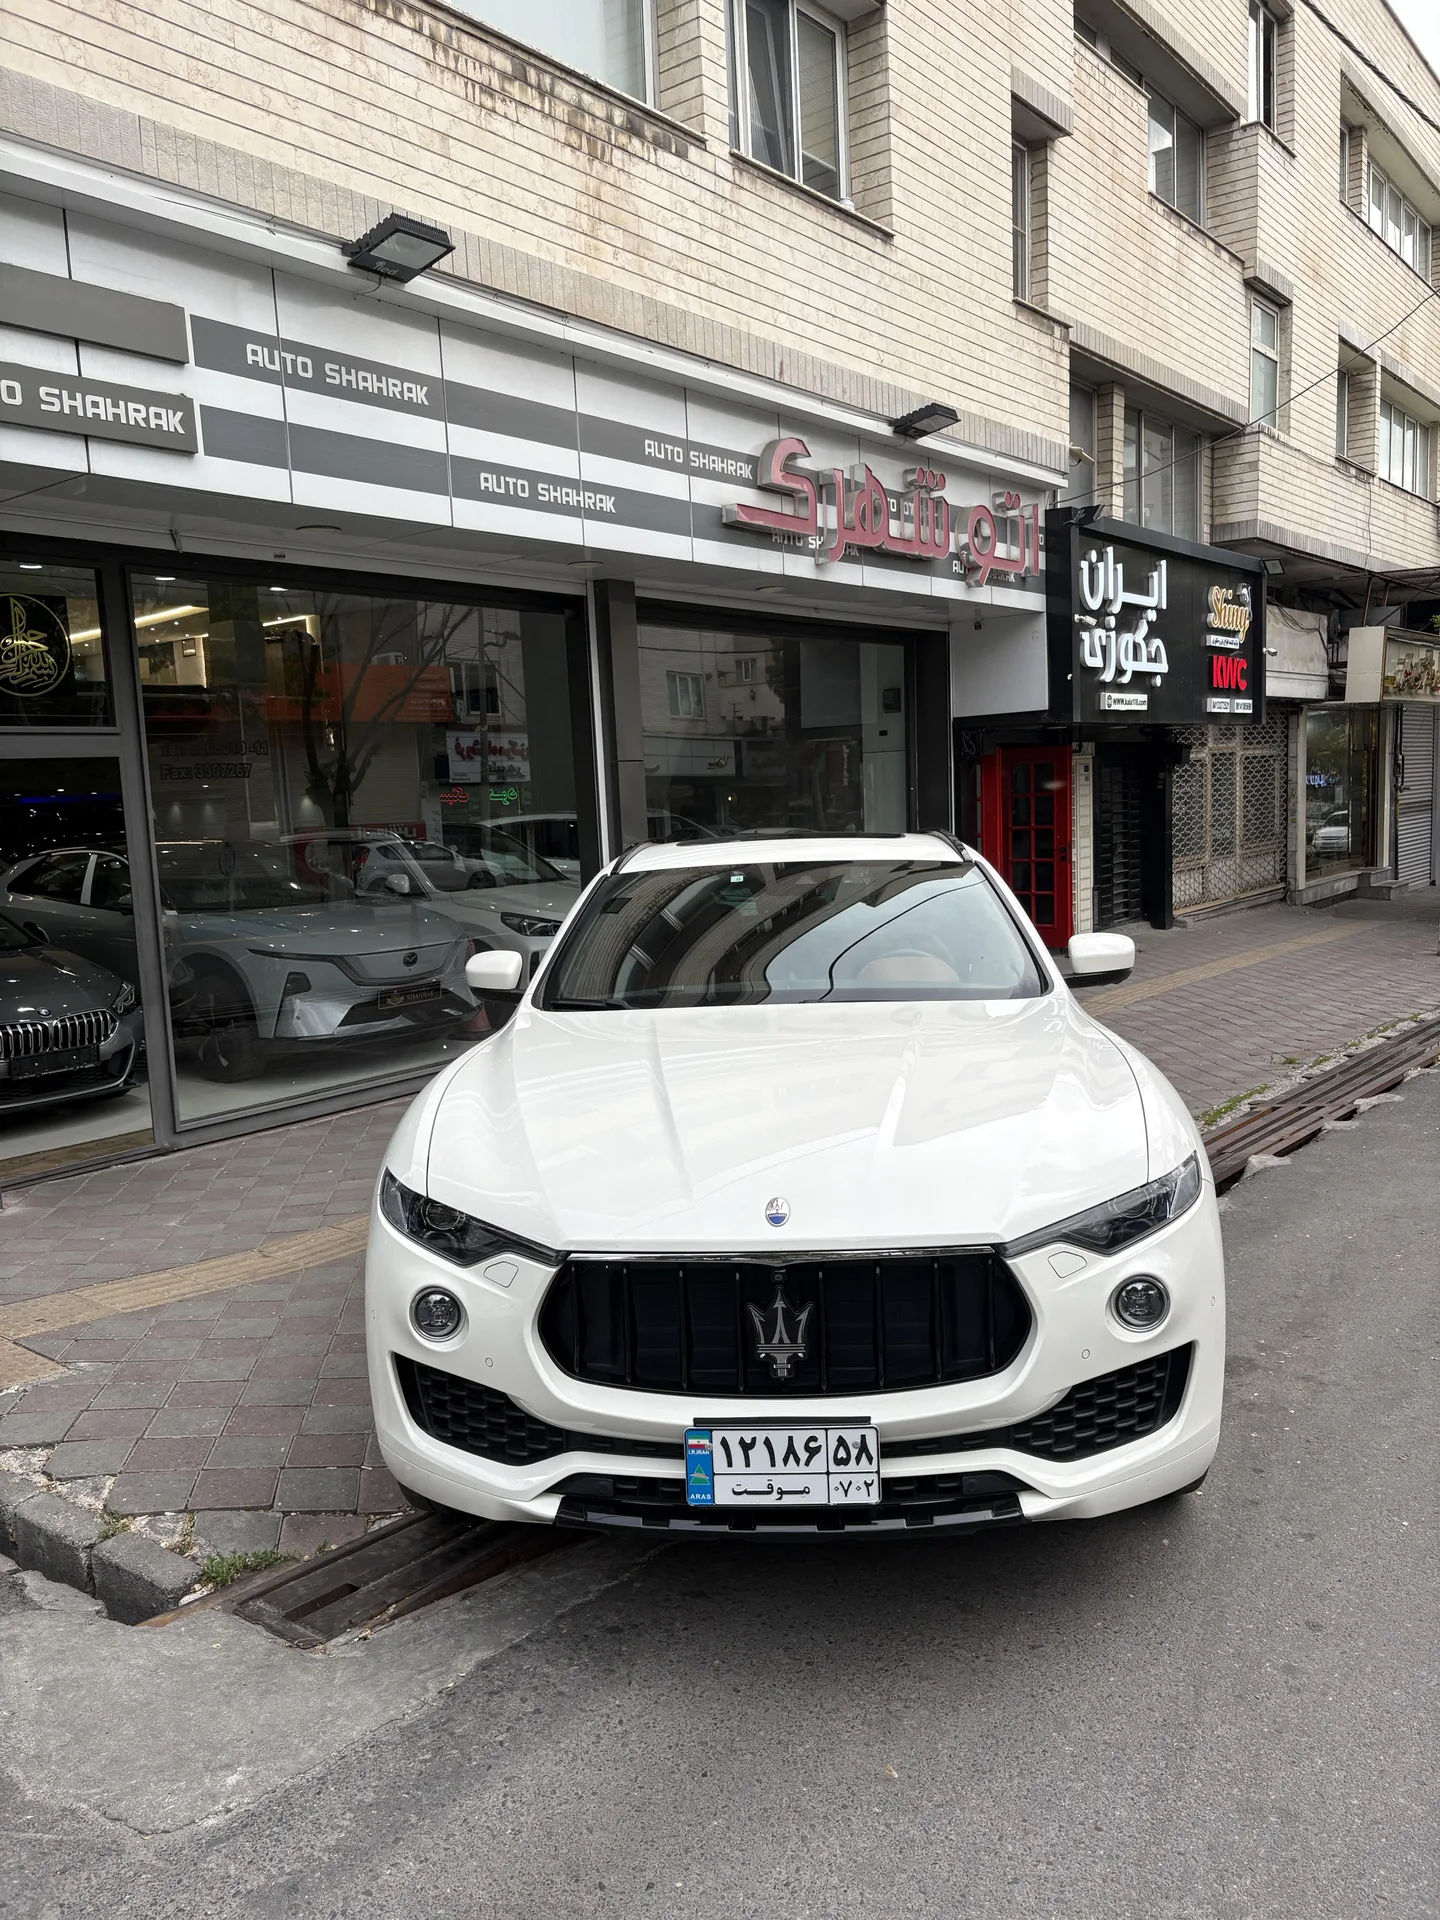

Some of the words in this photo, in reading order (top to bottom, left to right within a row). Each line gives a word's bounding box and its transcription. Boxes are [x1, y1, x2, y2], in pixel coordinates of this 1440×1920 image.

[245, 342, 314, 379] AUTO
[324, 363, 429, 406] SHAHRAK
[39, 386, 185, 435] SHAHRAK
[644, 438, 684, 464] AUTO
[690, 450, 753, 481] SHAHRAK
[480, 471, 530, 498] AUTO
[538, 483, 616, 514] SHAHRAK
[722, 436, 950, 565] شهرک
[956, 490, 1040, 588] اتو
[1079, 545, 1168, 622] ایران
[1208, 585, 1250, 644] Shiny
[1080, 614, 1169, 688] جکوزی
[1210, 654, 1248, 691] KWC
[719, 1435, 823, 1468] ۱۲۱۸۶
[832, 1434, 874, 1467] ۵۸
[731, 1478, 811, 1501] موقت
[833, 1478, 875, 1498] ۰۷۰۲
